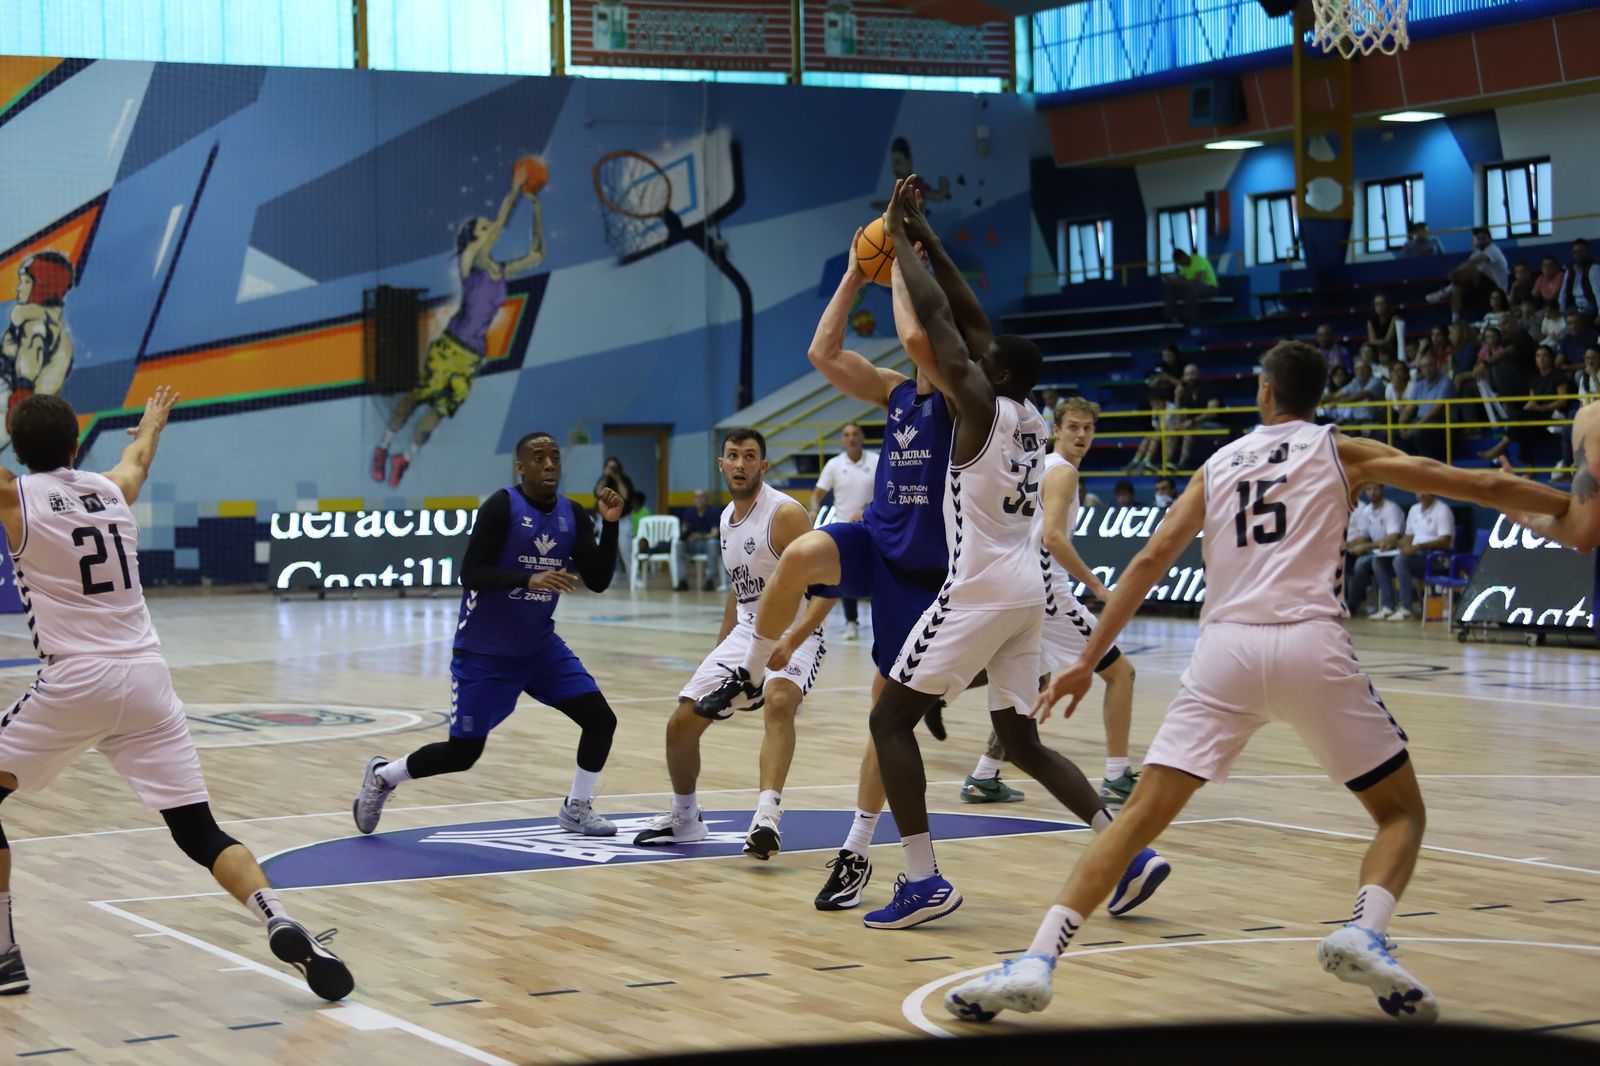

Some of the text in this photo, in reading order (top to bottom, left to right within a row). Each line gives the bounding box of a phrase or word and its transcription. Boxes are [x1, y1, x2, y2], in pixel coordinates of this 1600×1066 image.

[902, 449, 932, 460] RURAL
[1003, 459, 1039, 517] 35
[1235, 474, 1287, 547] 15
[72, 523, 132, 596] 21
